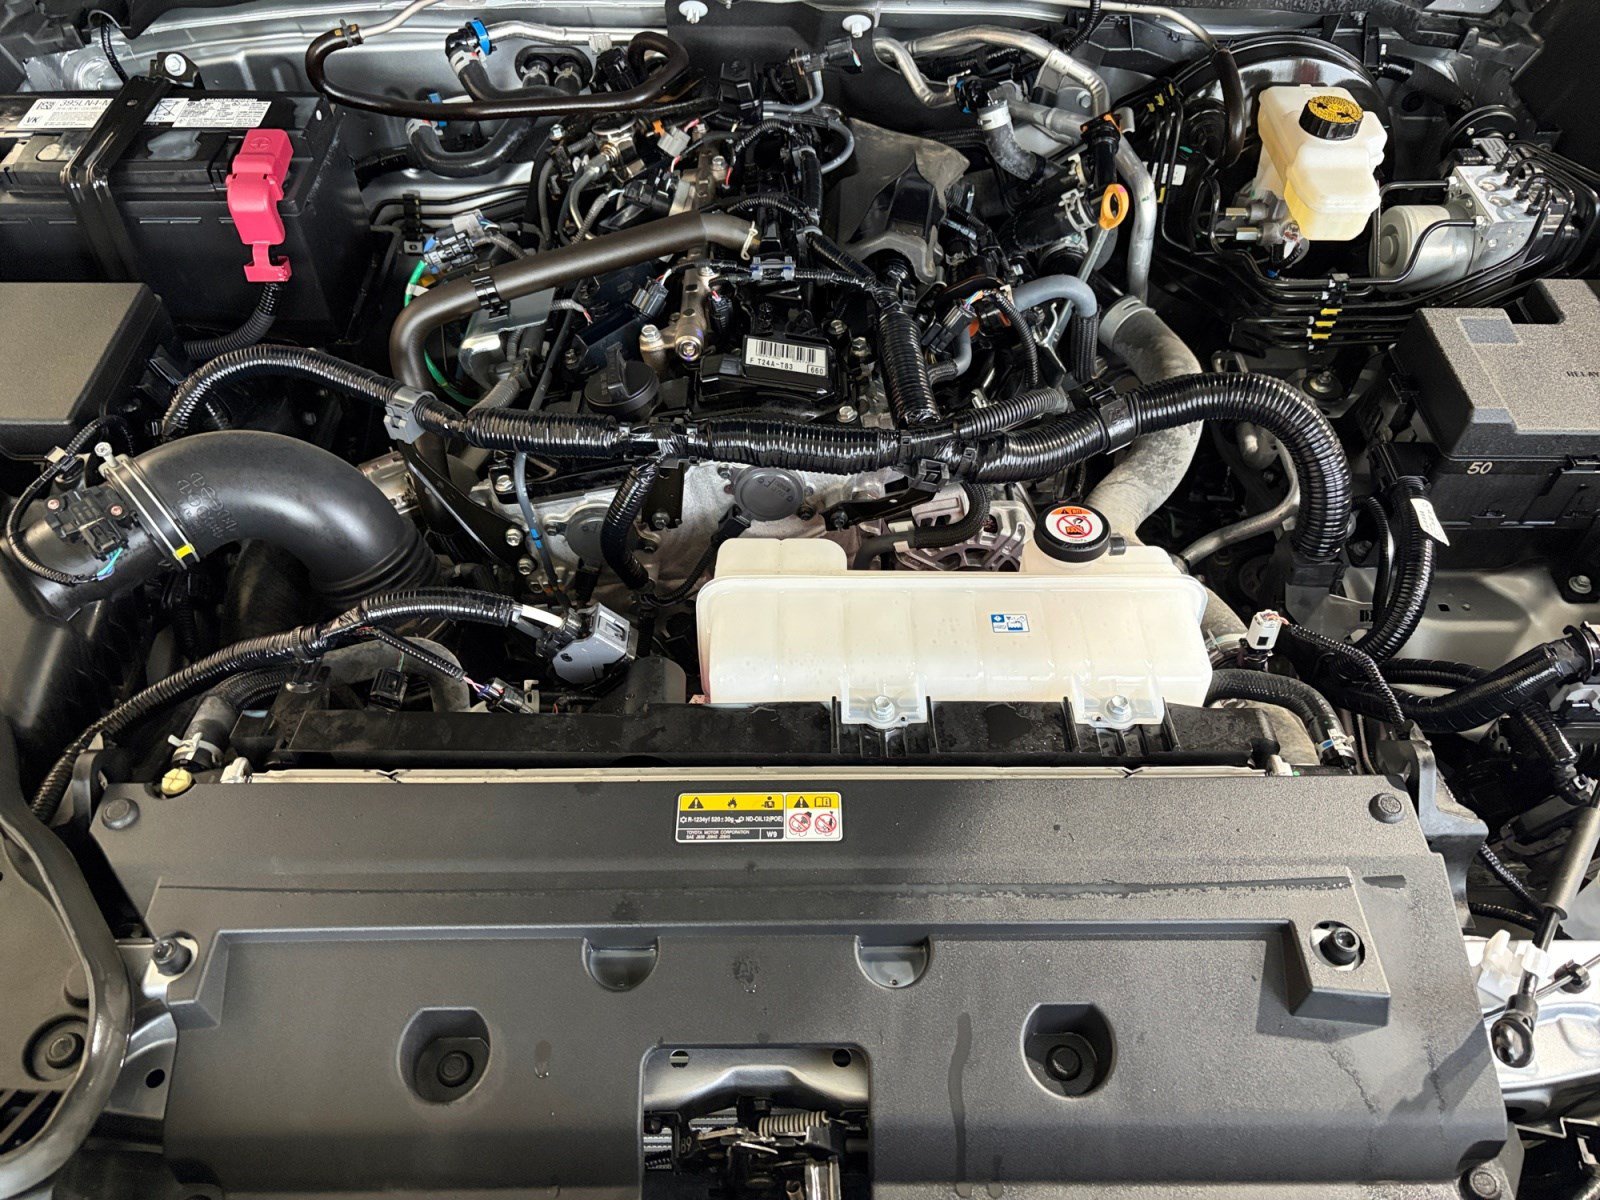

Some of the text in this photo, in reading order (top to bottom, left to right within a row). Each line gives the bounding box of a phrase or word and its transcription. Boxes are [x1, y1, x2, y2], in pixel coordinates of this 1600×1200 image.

[758, 359, 793, 369] T24A-T83
[1467, 461, 1493, 474] 50
[766, 830, 778, 838] W9
